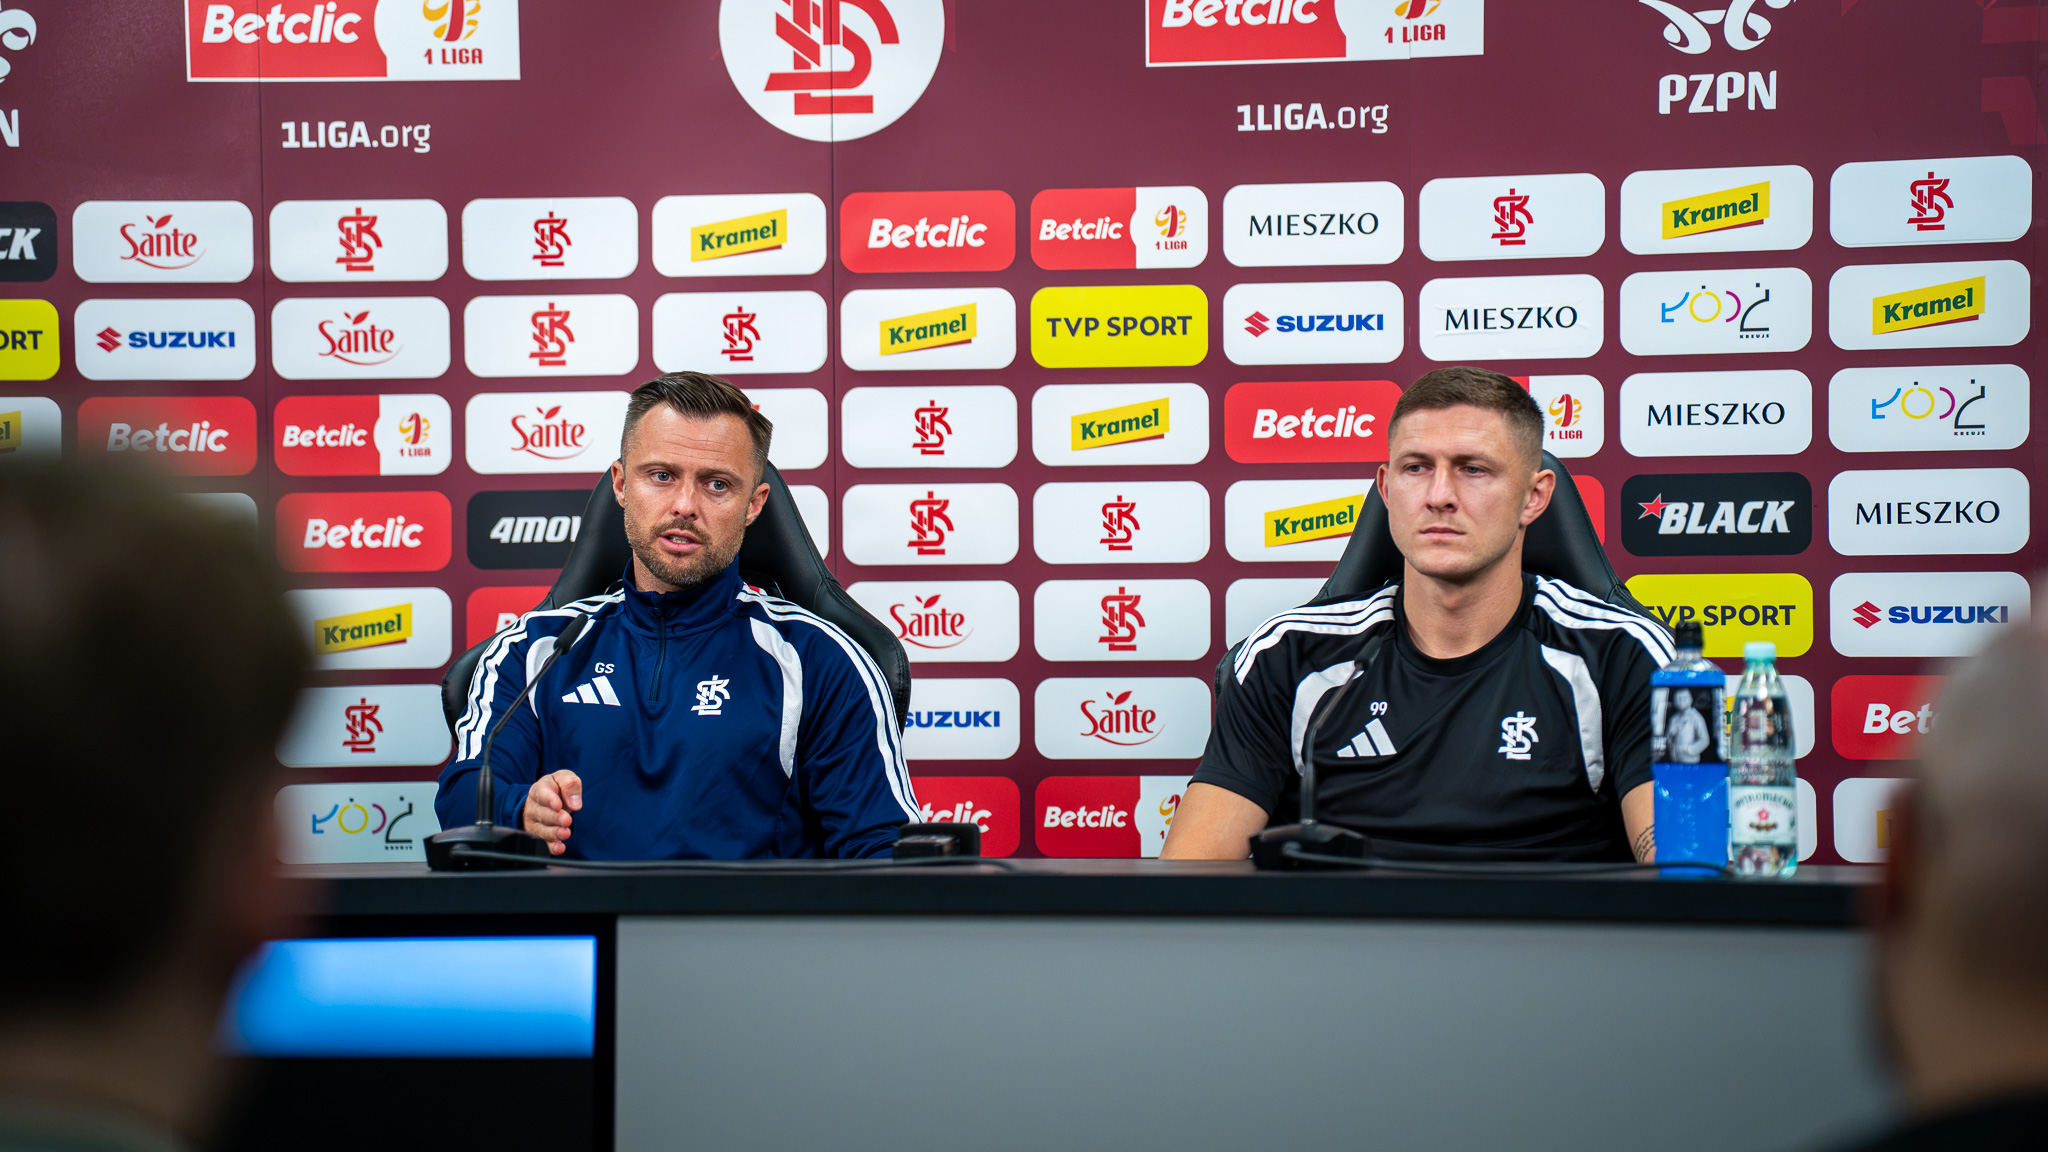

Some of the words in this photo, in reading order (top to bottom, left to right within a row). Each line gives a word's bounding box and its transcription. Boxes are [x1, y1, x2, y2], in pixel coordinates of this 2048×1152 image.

[202, 0, 362, 44] Betclic
[1384, 26, 1393, 44] 1
[1402, 23, 1446, 43] LIGA
[424, 48, 433, 65] 1
[441, 48, 483, 65] LIGA
[1658, 70, 1777, 115] PZPN
[1237, 102, 1389, 134] 1LIGA.org
[281, 120, 431, 154] 1LIGA.org
[1671, 192, 1759, 229] Kramel
[700, 219, 777, 251] Kramel
[867, 214, 988, 249] Betclic
[1038, 216, 1124, 241] Betclic
[1249, 212, 1379, 237] MIESZKO
[1155, 242, 1161, 250] 1
[1164, 241, 1188, 250] LIGA
[1445, 305, 1578, 331] MIESZKO
[1883, 287, 1974, 324] Kramel
[888, 313, 967, 346] Kramel
[1046, 317, 1100, 338] TVP
[1107, 315, 1193, 337] SPORT
[1276, 313, 1384, 333] SUZUKI
[0, 330, 43, 351] ORT
[127, 330, 236, 350] SUZUKI
[1080, 407, 1159, 441] Kramel
[1252, 405, 1376, 439] Betclic
[1647, 401, 1785, 427] MIESZKO
[106, 420, 229, 453] Betclic
[282, 423, 368, 447] Betclic
[1549, 431, 1555, 440] 1
[1558, 430, 1583, 440] LIGA
[408, 448, 431, 457] LIGA
[1274, 505, 1355, 536] Kramel
[1658, 501, 1796, 535] BLACK
[1856, 500, 2000, 525] MIESZKO
[303, 515, 424, 549] Betclic
[1645, 605, 1696, 622] VP
[1703, 604, 1796, 627] SPORT
[1888, 605, 2009, 625] SUZUKI
[323, 613, 402, 645] Kramel
[594, 662, 615, 674] GS
[1370, 701, 1388, 716] 99
[920, 800, 992, 833] tclic
[1043, 804, 1128, 828] Betclic
